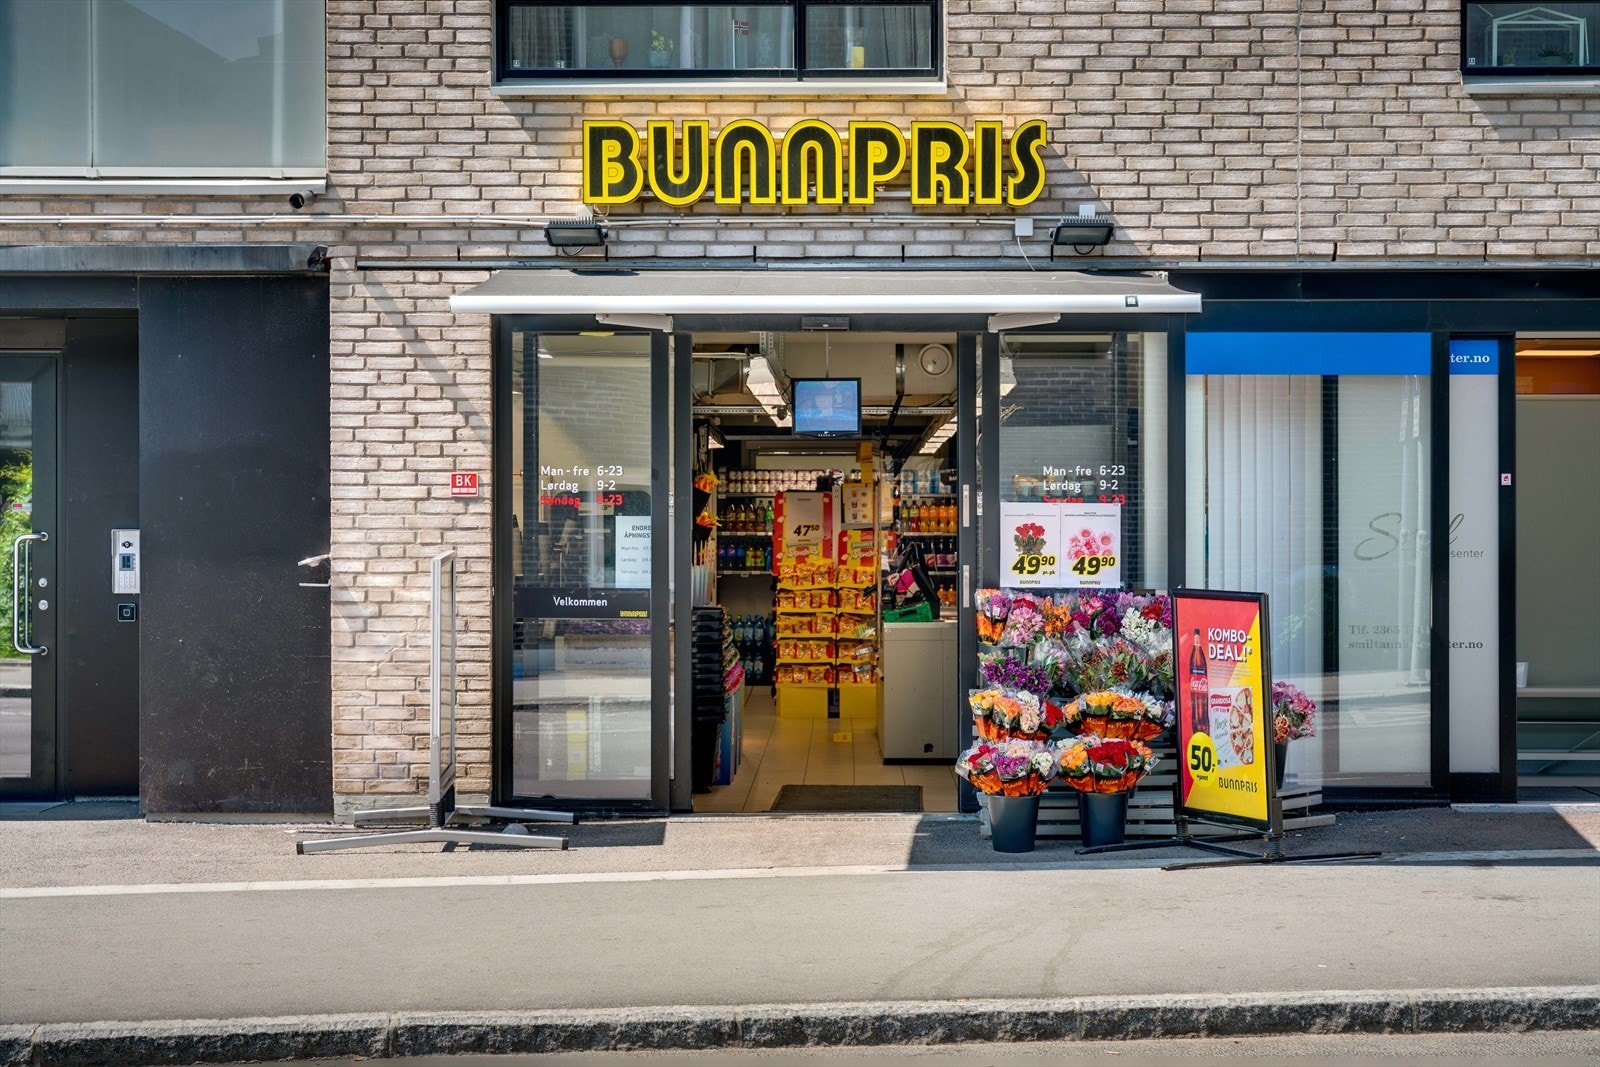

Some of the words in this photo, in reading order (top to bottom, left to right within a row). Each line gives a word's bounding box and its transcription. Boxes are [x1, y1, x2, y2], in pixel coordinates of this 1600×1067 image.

[582, 119, 1048, 207] BUNNPRIS
[597, 466, 623, 476] 6-23
[1100, 465, 1126, 476] 6-23
[455, 474, 472, 487] BK
[541, 480, 579, 493] Lørdag
[597, 480, 616, 491] 9-2
[1043, 480, 1081, 493] Lørdag
[1100, 479, 1118, 490] 9-2
[553, 596, 608, 607] Velkommen
[1207, 627, 1252, 643] KOMBO-
[1218, 777, 1258, 793] BUNNPRIS
